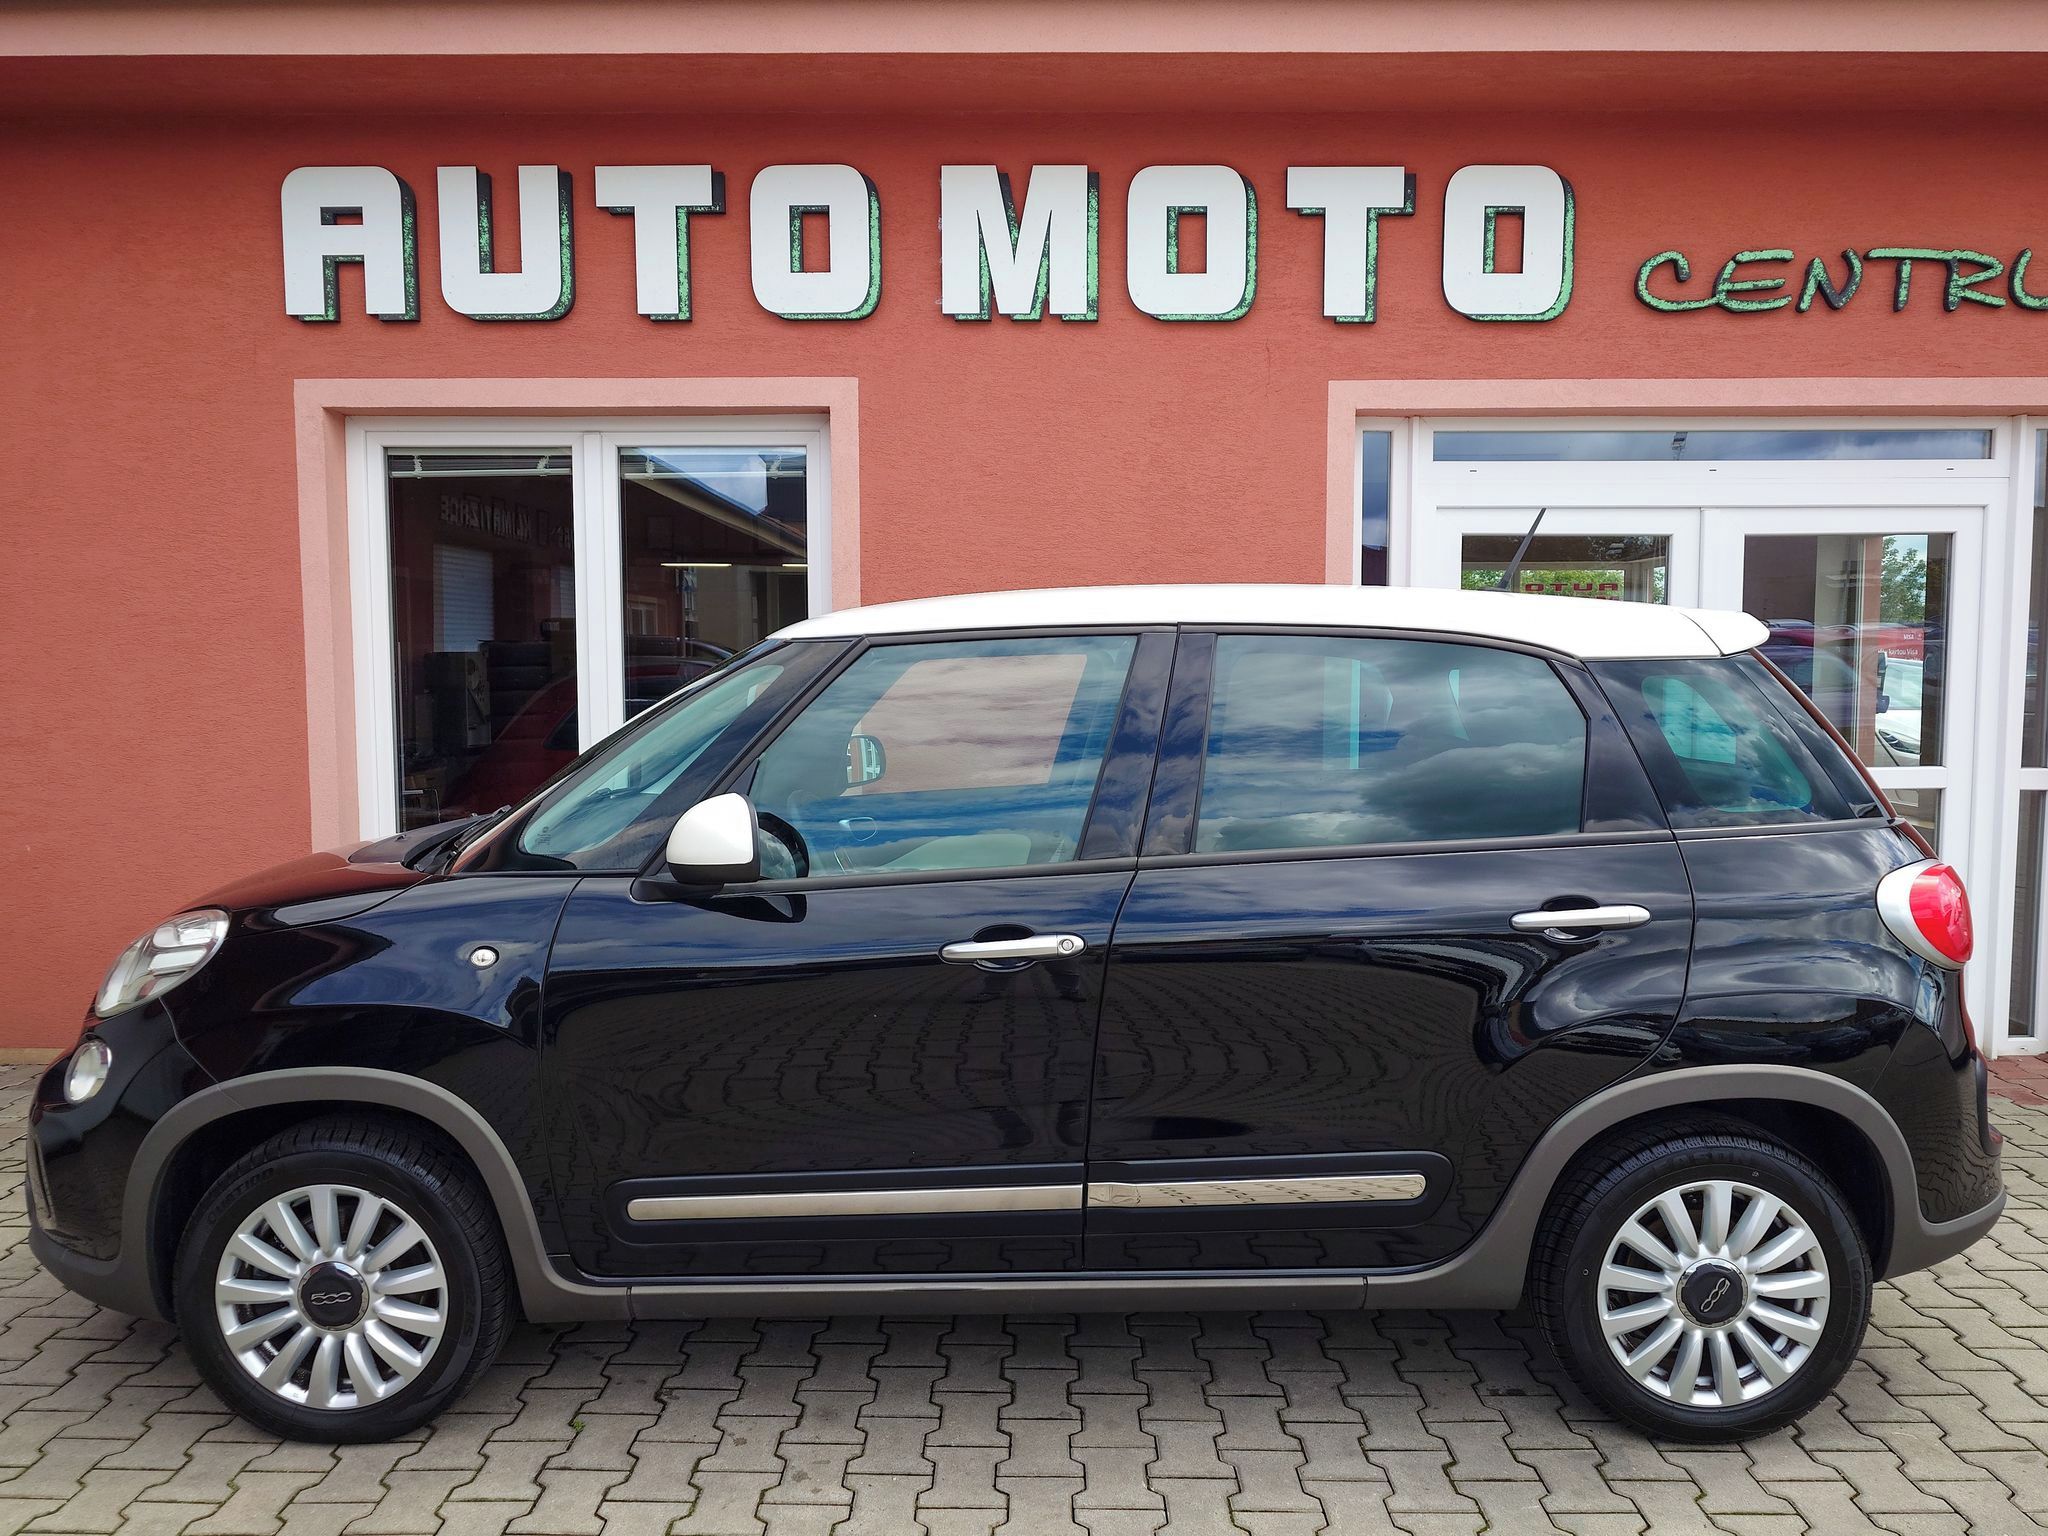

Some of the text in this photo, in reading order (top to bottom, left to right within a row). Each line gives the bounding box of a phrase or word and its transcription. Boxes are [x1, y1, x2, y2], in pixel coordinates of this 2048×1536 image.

[281, 163, 882, 322] AUTO
[940, 163, 1576, 323] MOTO
[311, 1291, 352, 1305] 500
